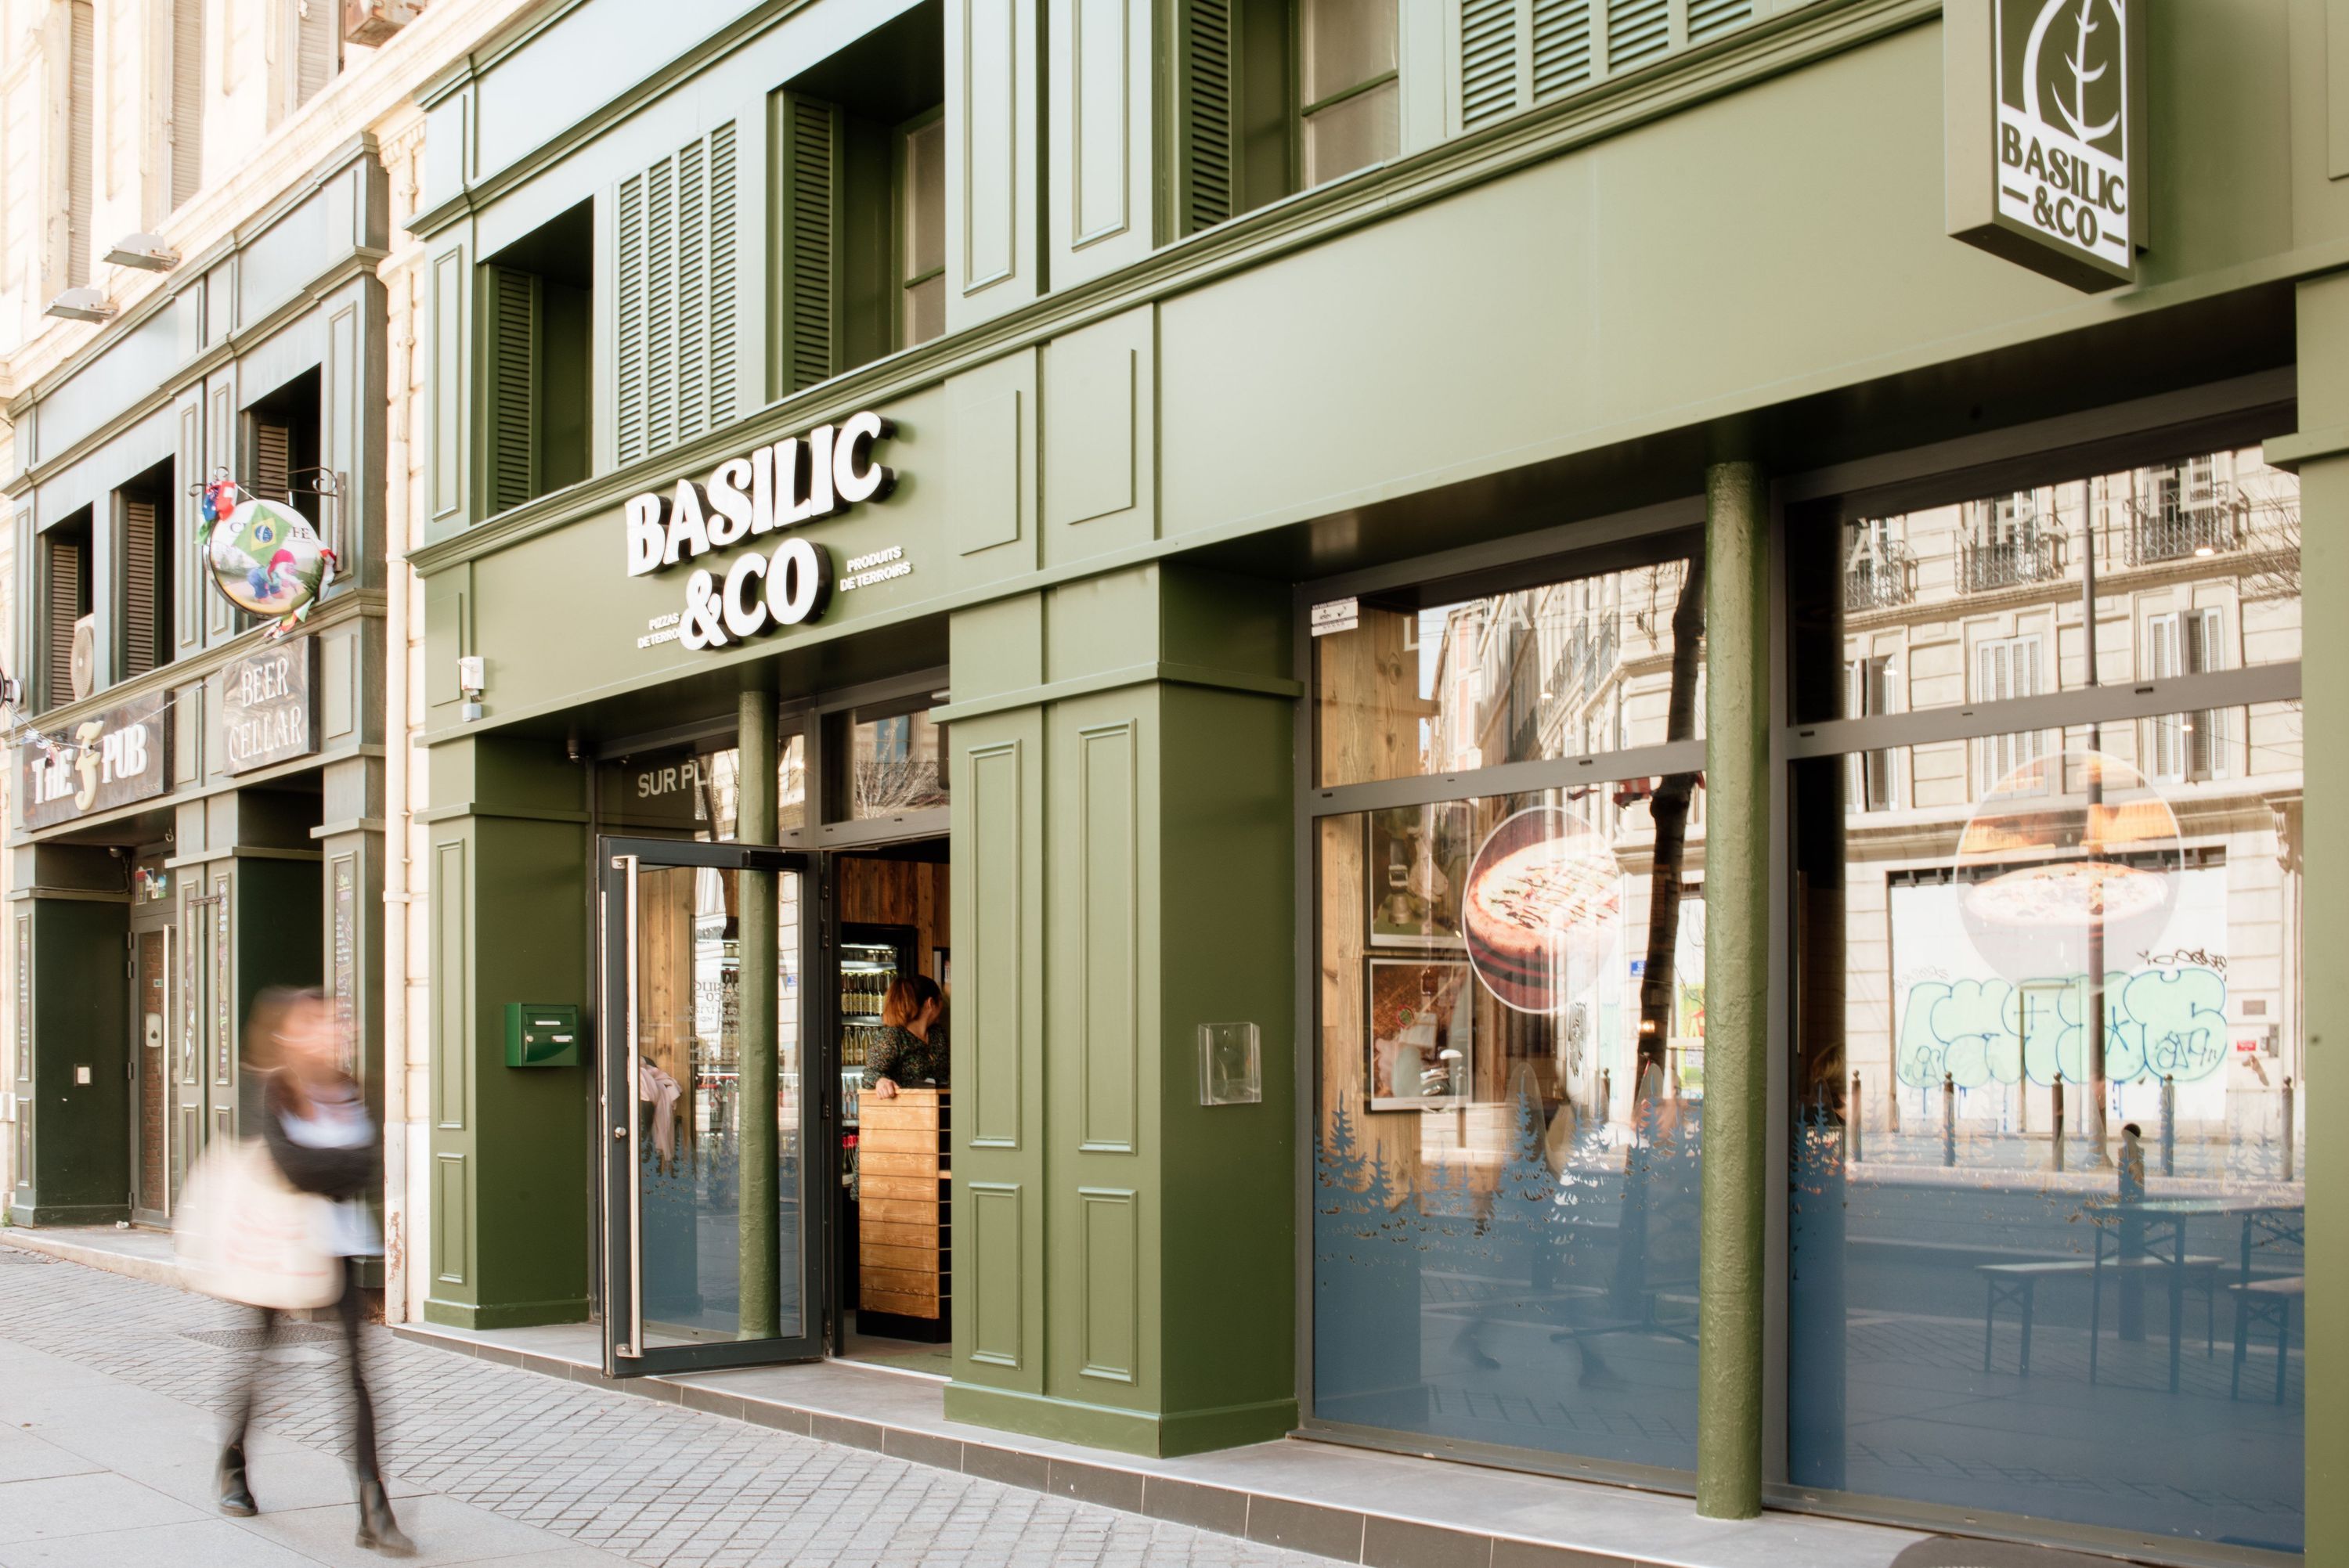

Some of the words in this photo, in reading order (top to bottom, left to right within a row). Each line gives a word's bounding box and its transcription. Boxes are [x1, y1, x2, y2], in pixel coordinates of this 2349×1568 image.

[2001, 121, 2126, 214] BASILIC
[2033, 185, 2098, 247] &CO
[624, 410, 882, 578] BASILIC
[839, 576, 856, 592] DE
[855, 561, 911, 587] TERROIRS
[846, 546, 903, 572] PRODUITS
[648, 612, 680, 630] PIZZAS
[680, 537, 819, 651] &CO
[637, 636, 651, 649] DE
[241, 657, 289, 708] BEER
[228, 705, 302, 762] CELLAR
[31, 748, 74, 804] THE
[101, 724, 149, 784] PUB
[638, 767, 677, 798] SUR
